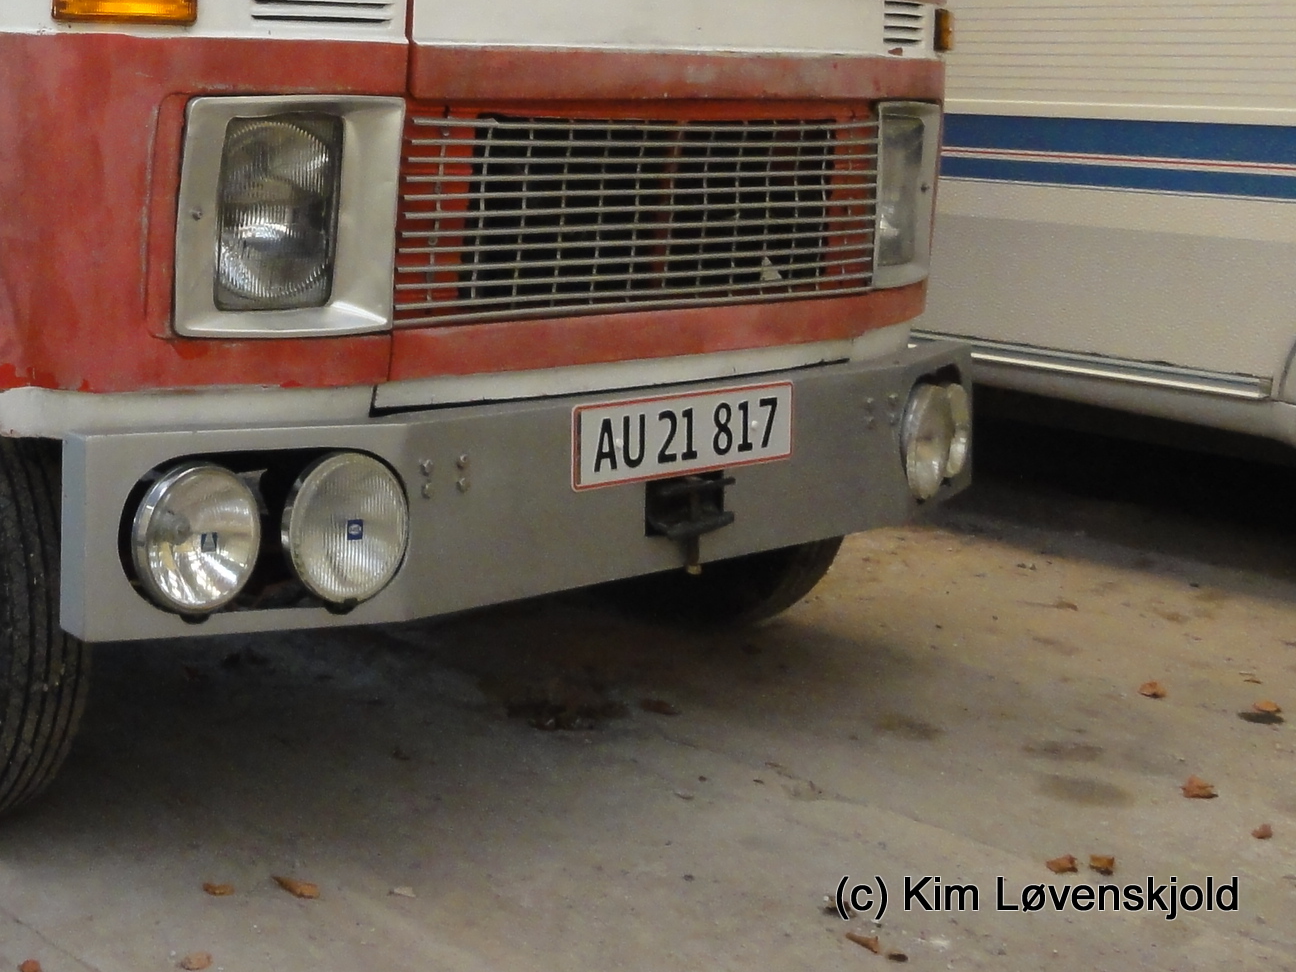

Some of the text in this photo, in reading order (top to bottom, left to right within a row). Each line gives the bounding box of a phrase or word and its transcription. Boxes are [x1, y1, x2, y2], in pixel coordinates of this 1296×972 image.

[593, 396, 779, 473] AU 21 817
